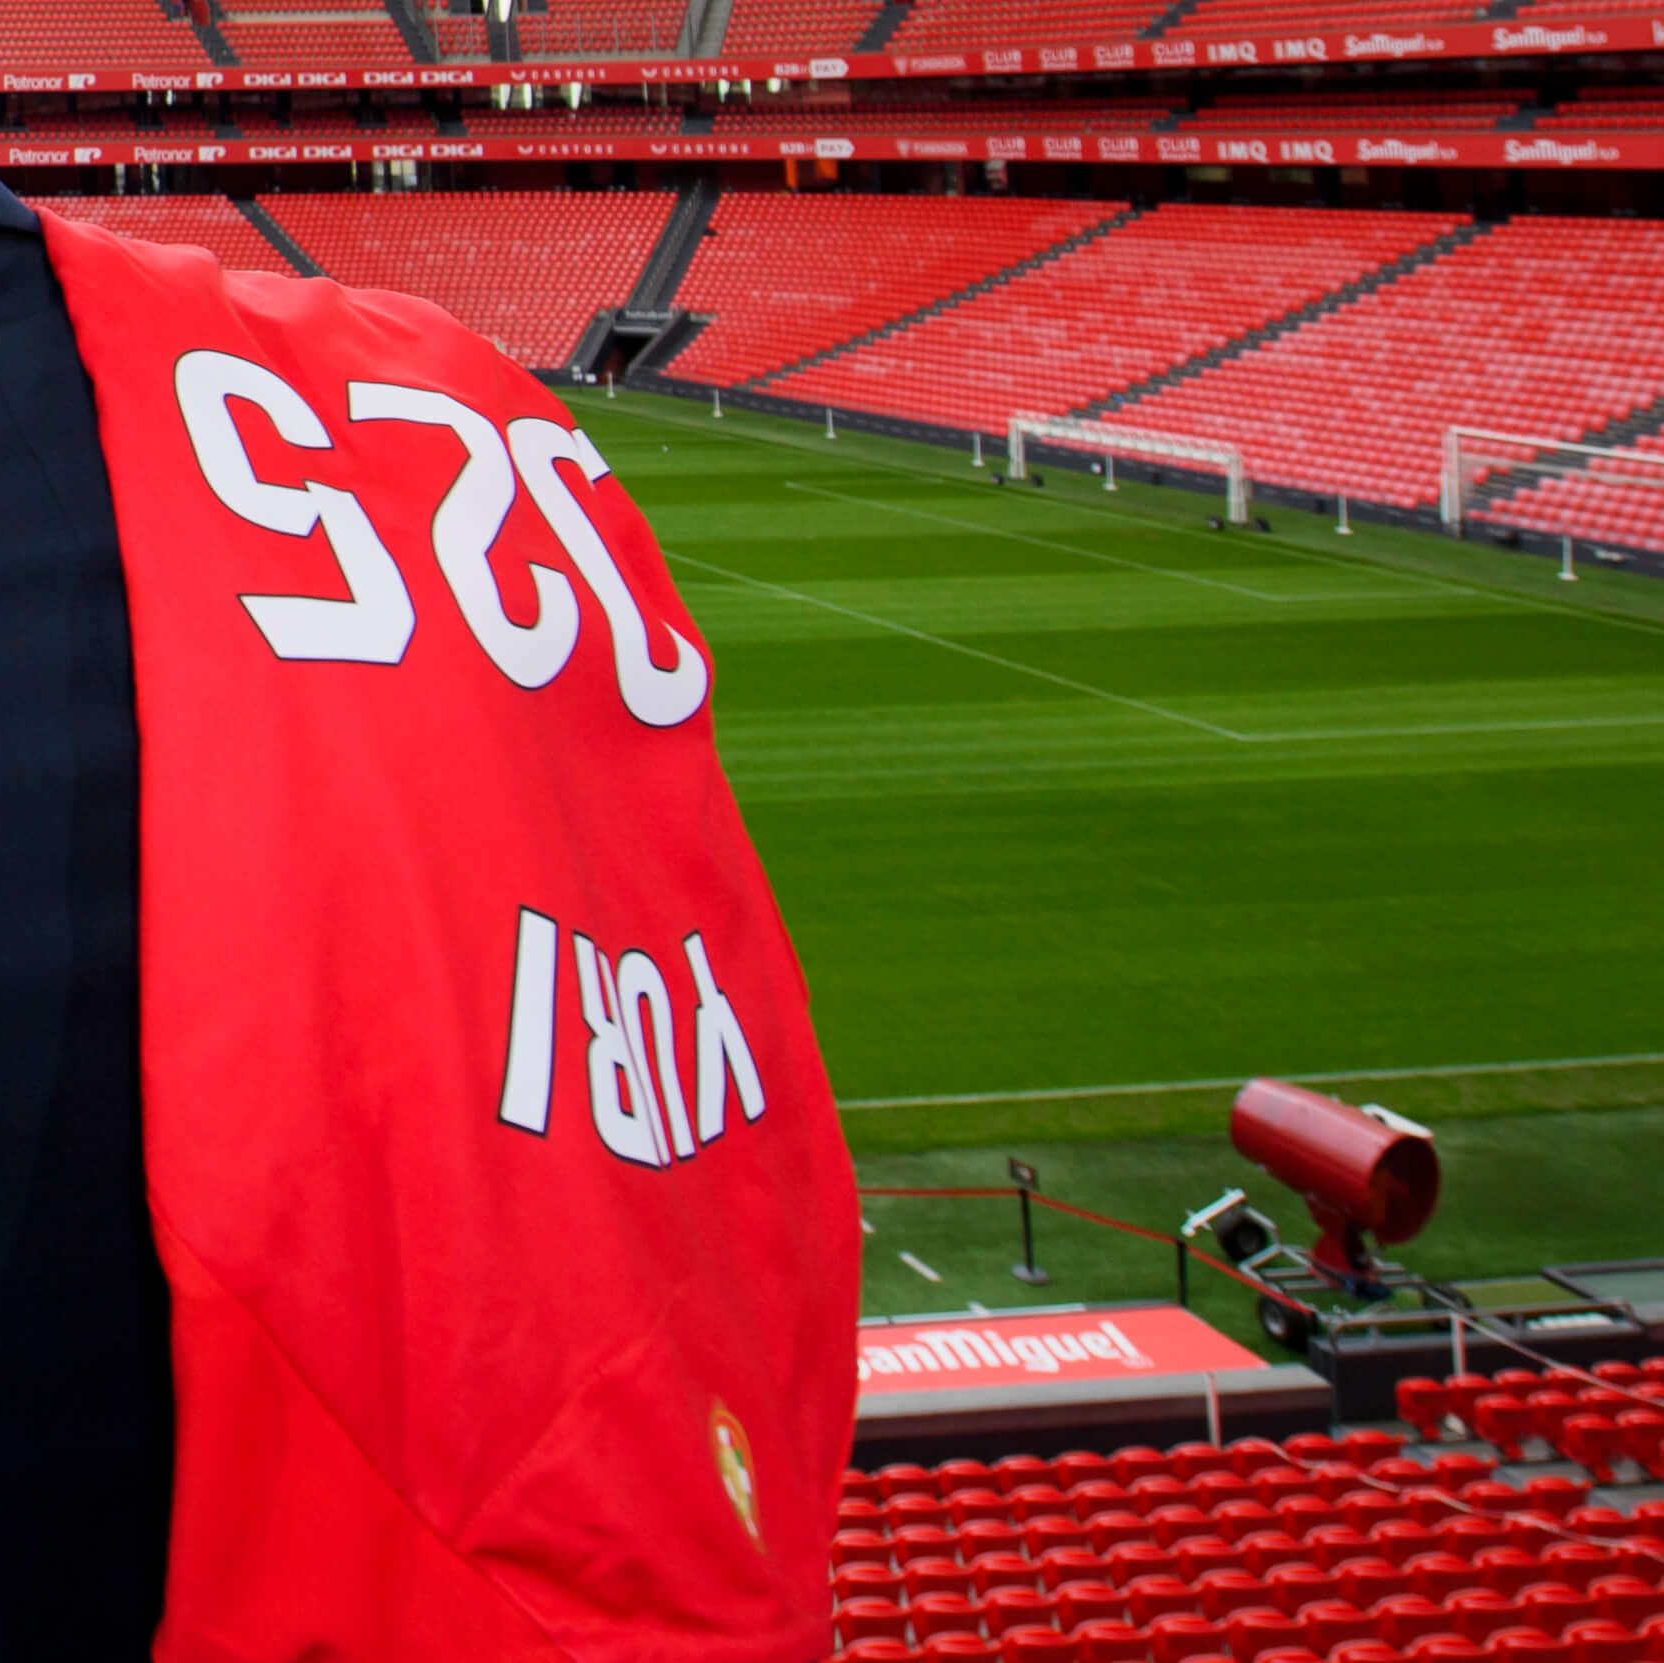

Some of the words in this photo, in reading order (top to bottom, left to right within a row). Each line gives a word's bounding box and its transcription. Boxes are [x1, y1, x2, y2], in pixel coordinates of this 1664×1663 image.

[1207, 41, 1258, 63] IMQ
[1273, 38, 1328, 61] IMQ
[3, 73, 63, 91] Petronor
[132, 72, 191, 90] Petronor
[9, 148, 69, 165] Petronor
[134, 146, 194, 164] Petronor
[1217, 139, 1270, 164] IMQ
[1280, 139, 1335, 164] IMQ
[498, 904, 766, 1170] YURI
[858, 1321, 1146, 1381] anMiguel
